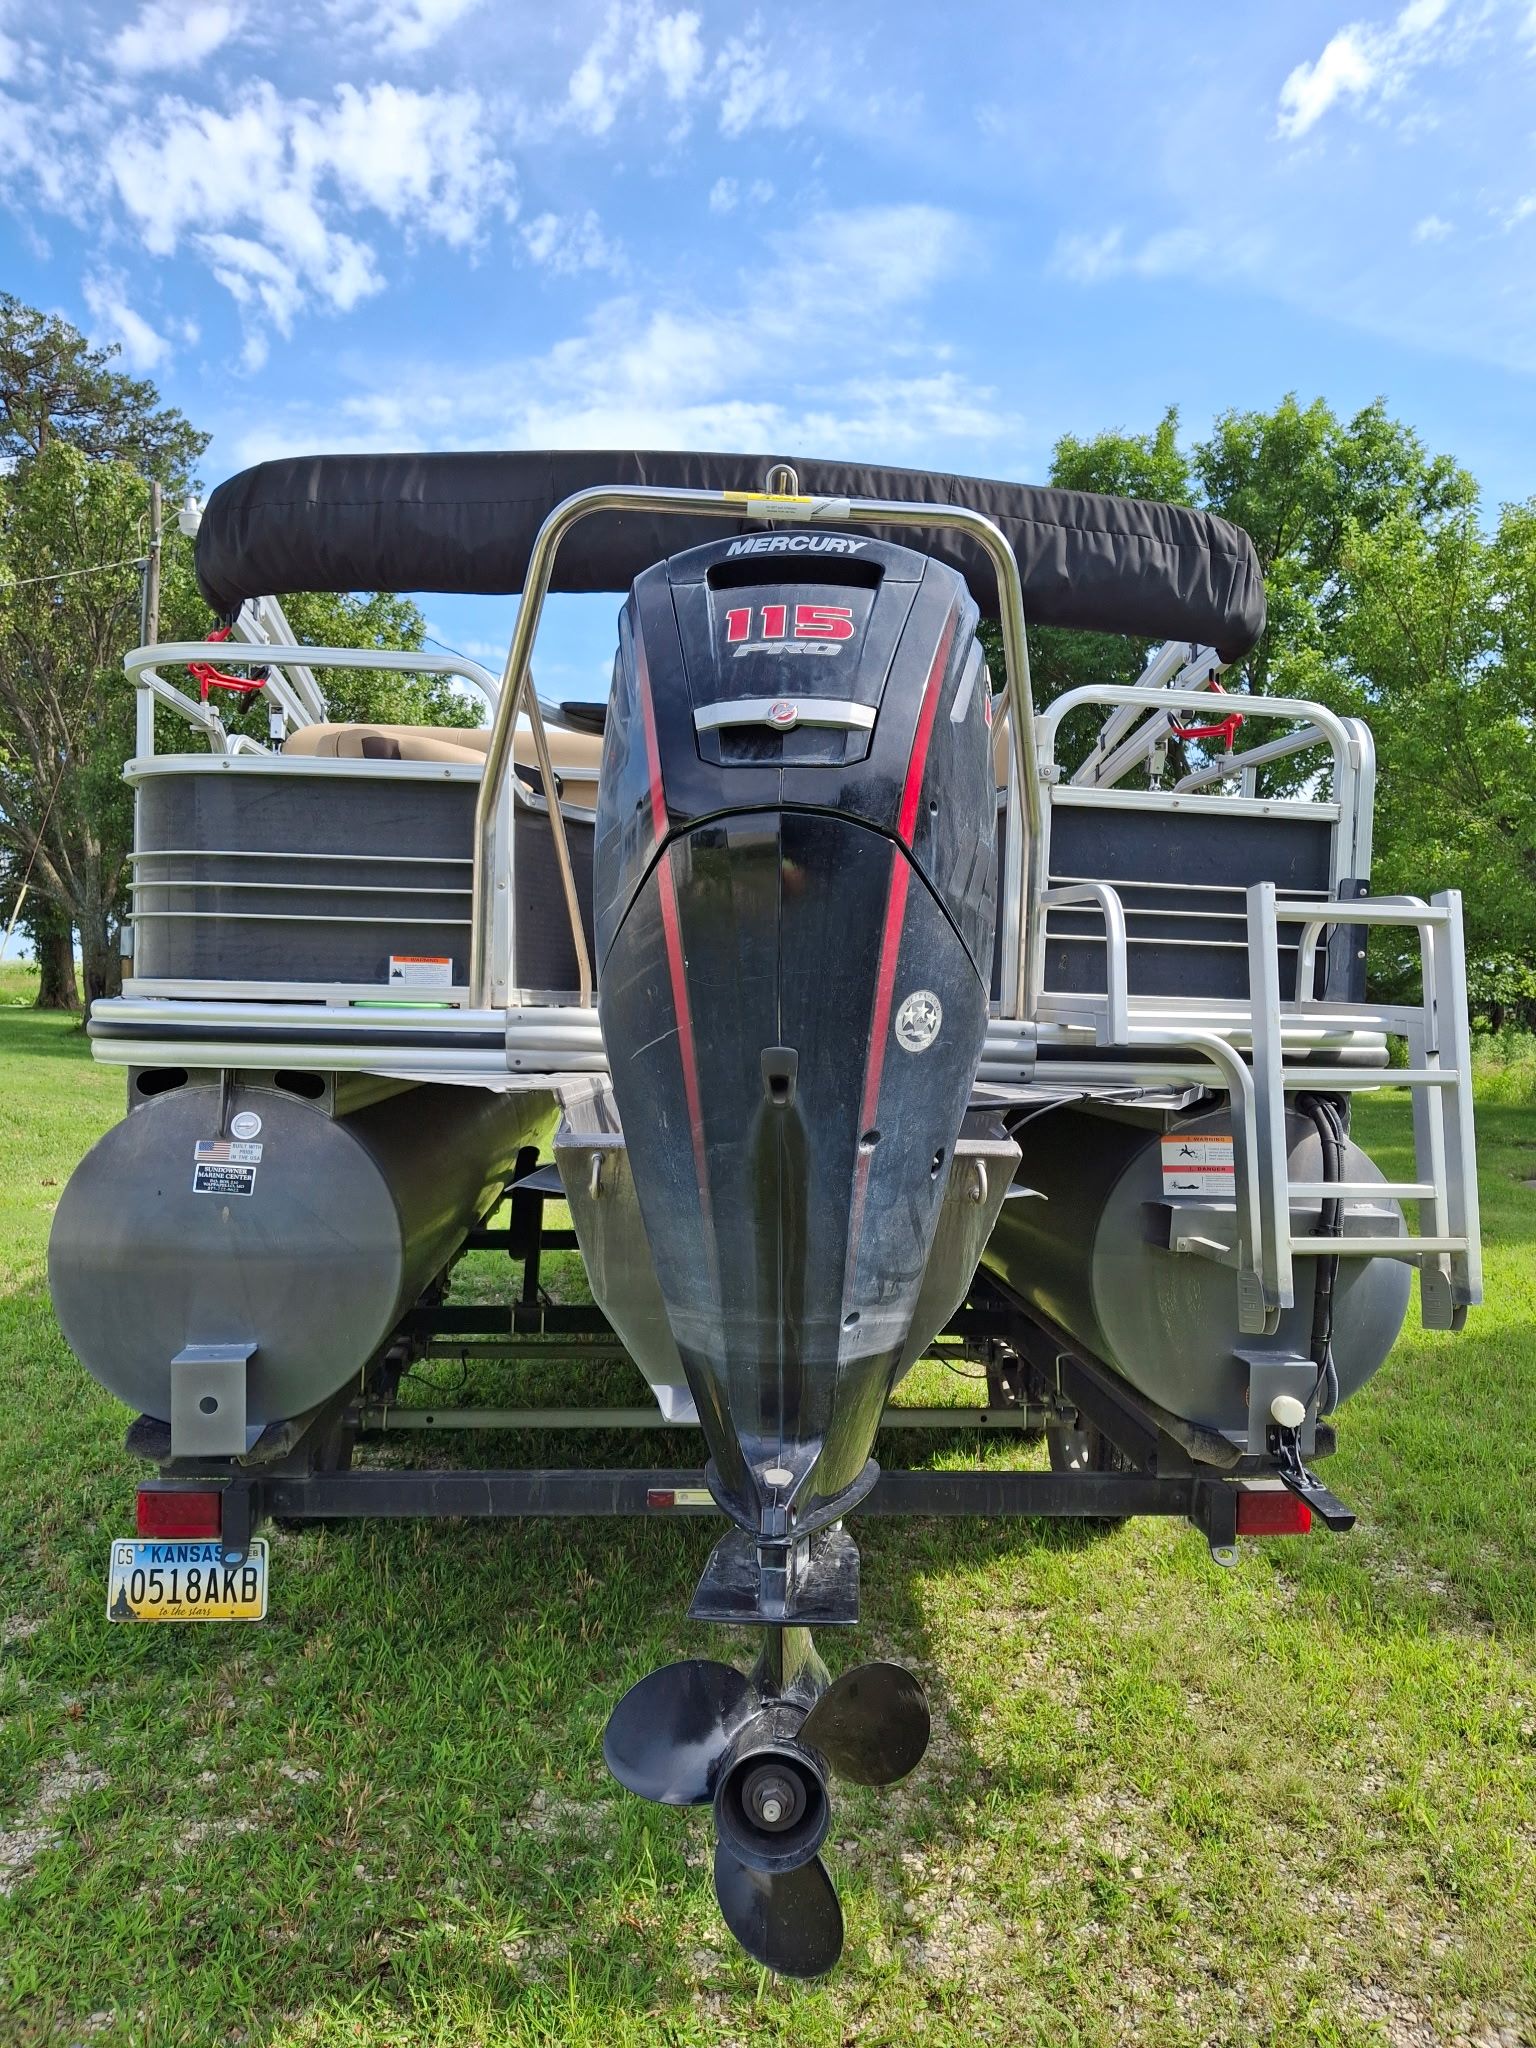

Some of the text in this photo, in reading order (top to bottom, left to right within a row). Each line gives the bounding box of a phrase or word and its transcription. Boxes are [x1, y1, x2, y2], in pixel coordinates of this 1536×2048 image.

[726, 536, 867, 557] MERCURY
[726, 605, 855, 642] 115
[732, 642, 843, 657] PRO
[118, 1549, 133, 1565] CS
[151, 1545, 223, 1563] KANSAS
[130, 1568, 257, 1604] 0518AKB
[159, 1602, 212, 1616] to the stars
